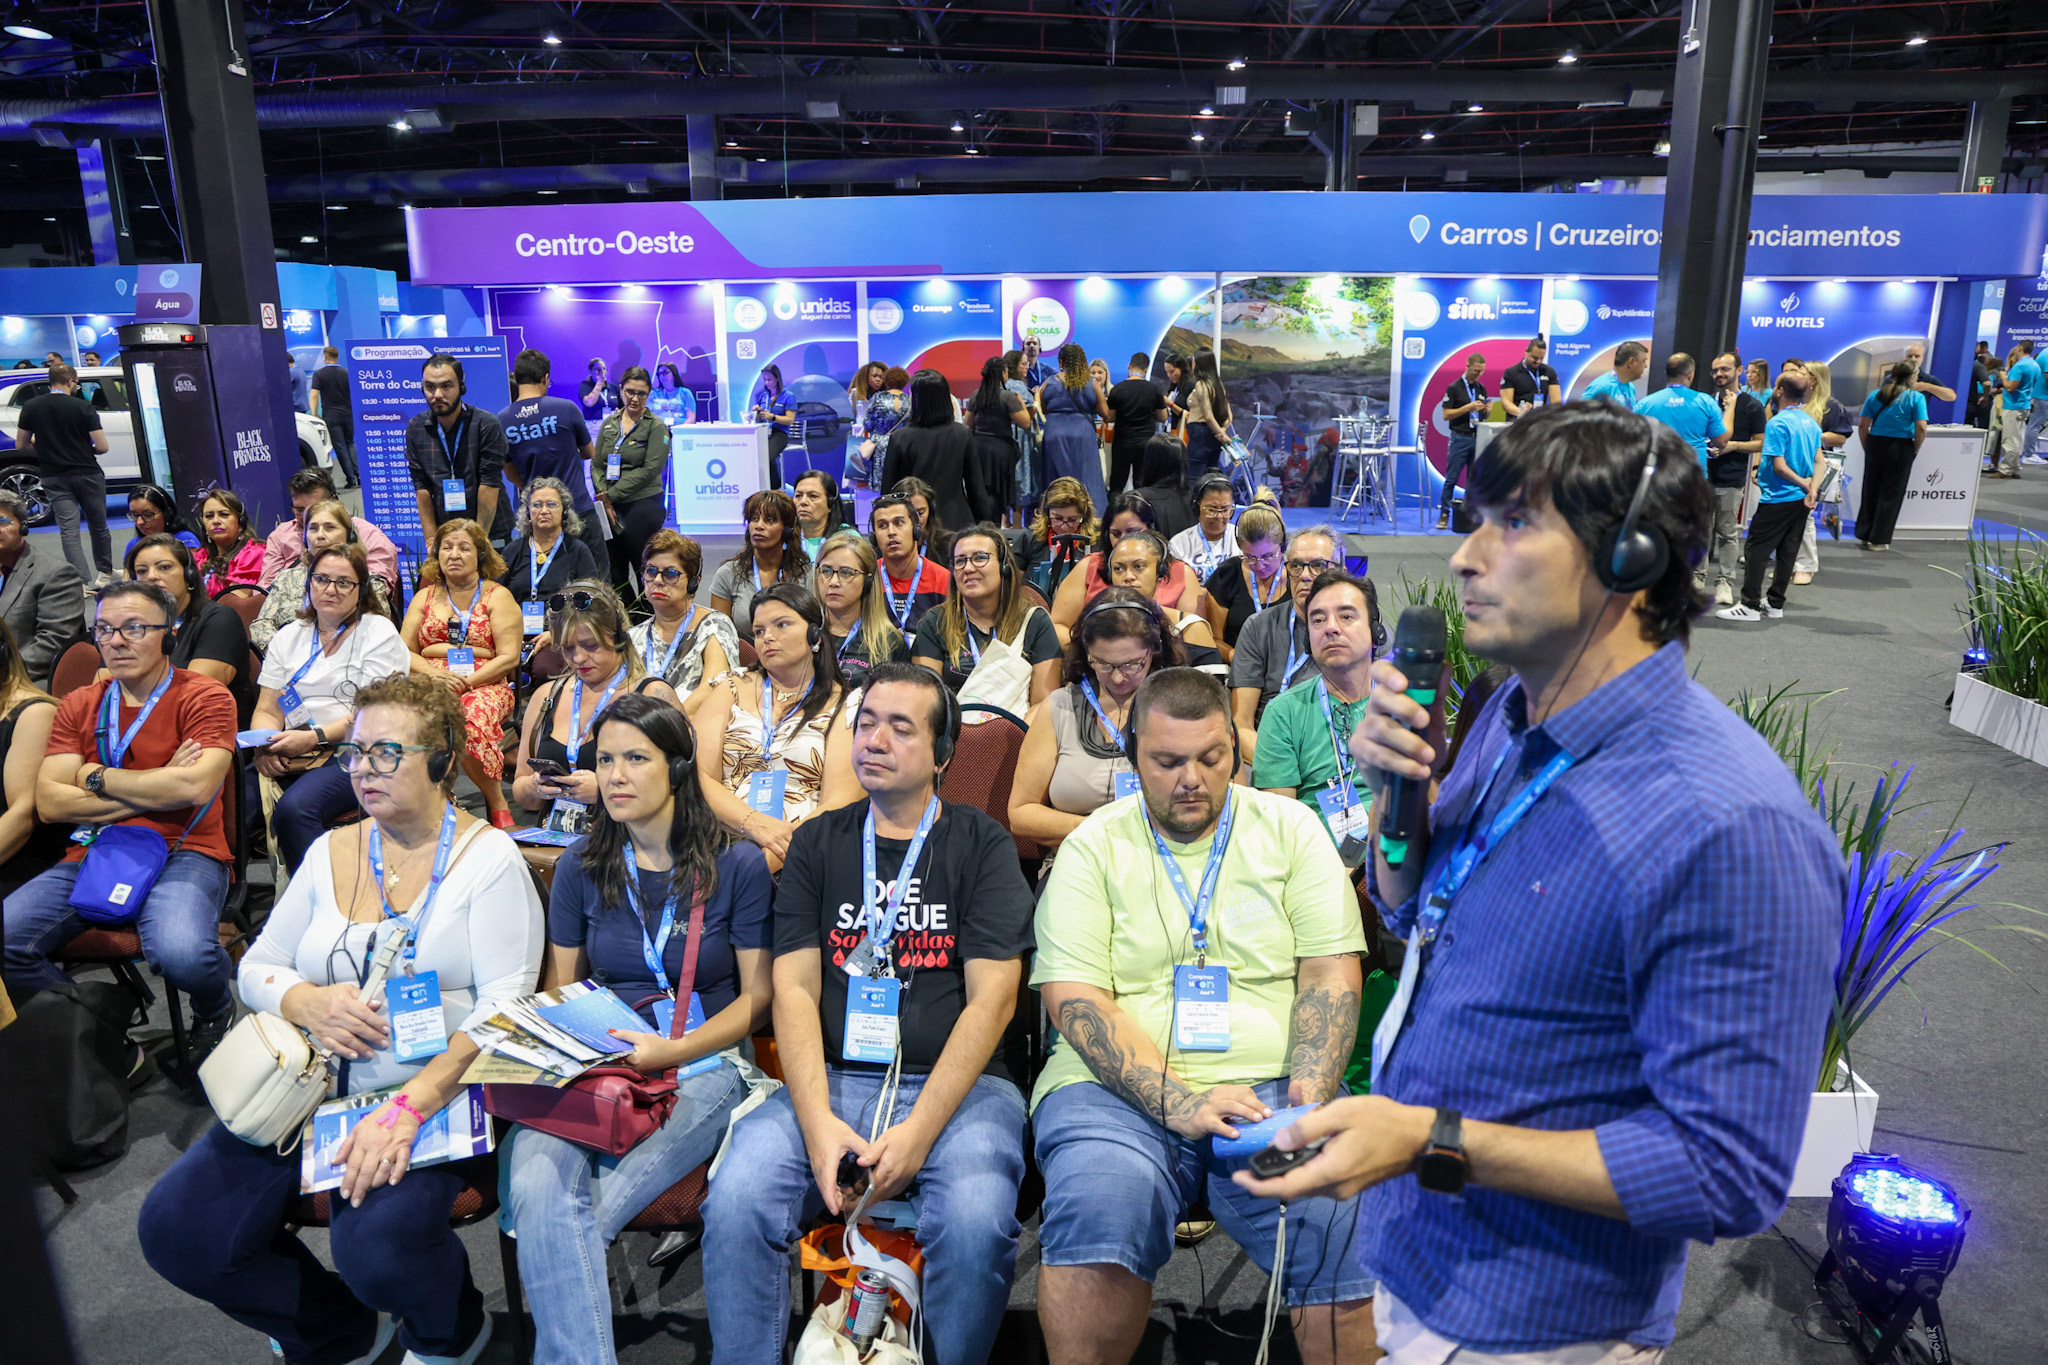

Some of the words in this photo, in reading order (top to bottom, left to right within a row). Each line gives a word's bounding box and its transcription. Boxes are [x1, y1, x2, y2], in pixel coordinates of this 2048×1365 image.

[1440, 222, 1528, 245] Carros
[1750, 224, 1901, 247] nciamentos
[515, 230, 695, 258] Centro-Oeste
[155, 298, 180, 311] Água
[378, 295, 398, 307] rdeste
[800, 297, 851, 313] unidas
[921, 305, 952, 314] Losango
[801, 313, 823, 321] aluguel
[1751, 316, 1774, 328] VIP
[1775, 316, 1825, 328] HOTELS
[1033, 325, 1061, 335] GOIÁS
[365, 348, 423, 358] Programação
[358, 370, 384, 380] SALA
[385, 369, 393, 379] 3
[359, 381, 385, 390] Torre
[387, 380, 400, 389] do
[402, 379, 422, 389] Cas
[520, 402, 540, 413] Azul
[363, 414, 401, 422] Capacitação
[505, 415, 558, 445] Staff
[236, 429, 263, 450] BLACK
[695, 481, 740, 495] unidas
[1906, 490, 1918, 499] IP
[1921, 490, 1967, 500] HOTELS
[840, 657, 870, 669] ratinas
[828, 928, 868, 950] Sal
[861, 985, 886, 993] Campinas
